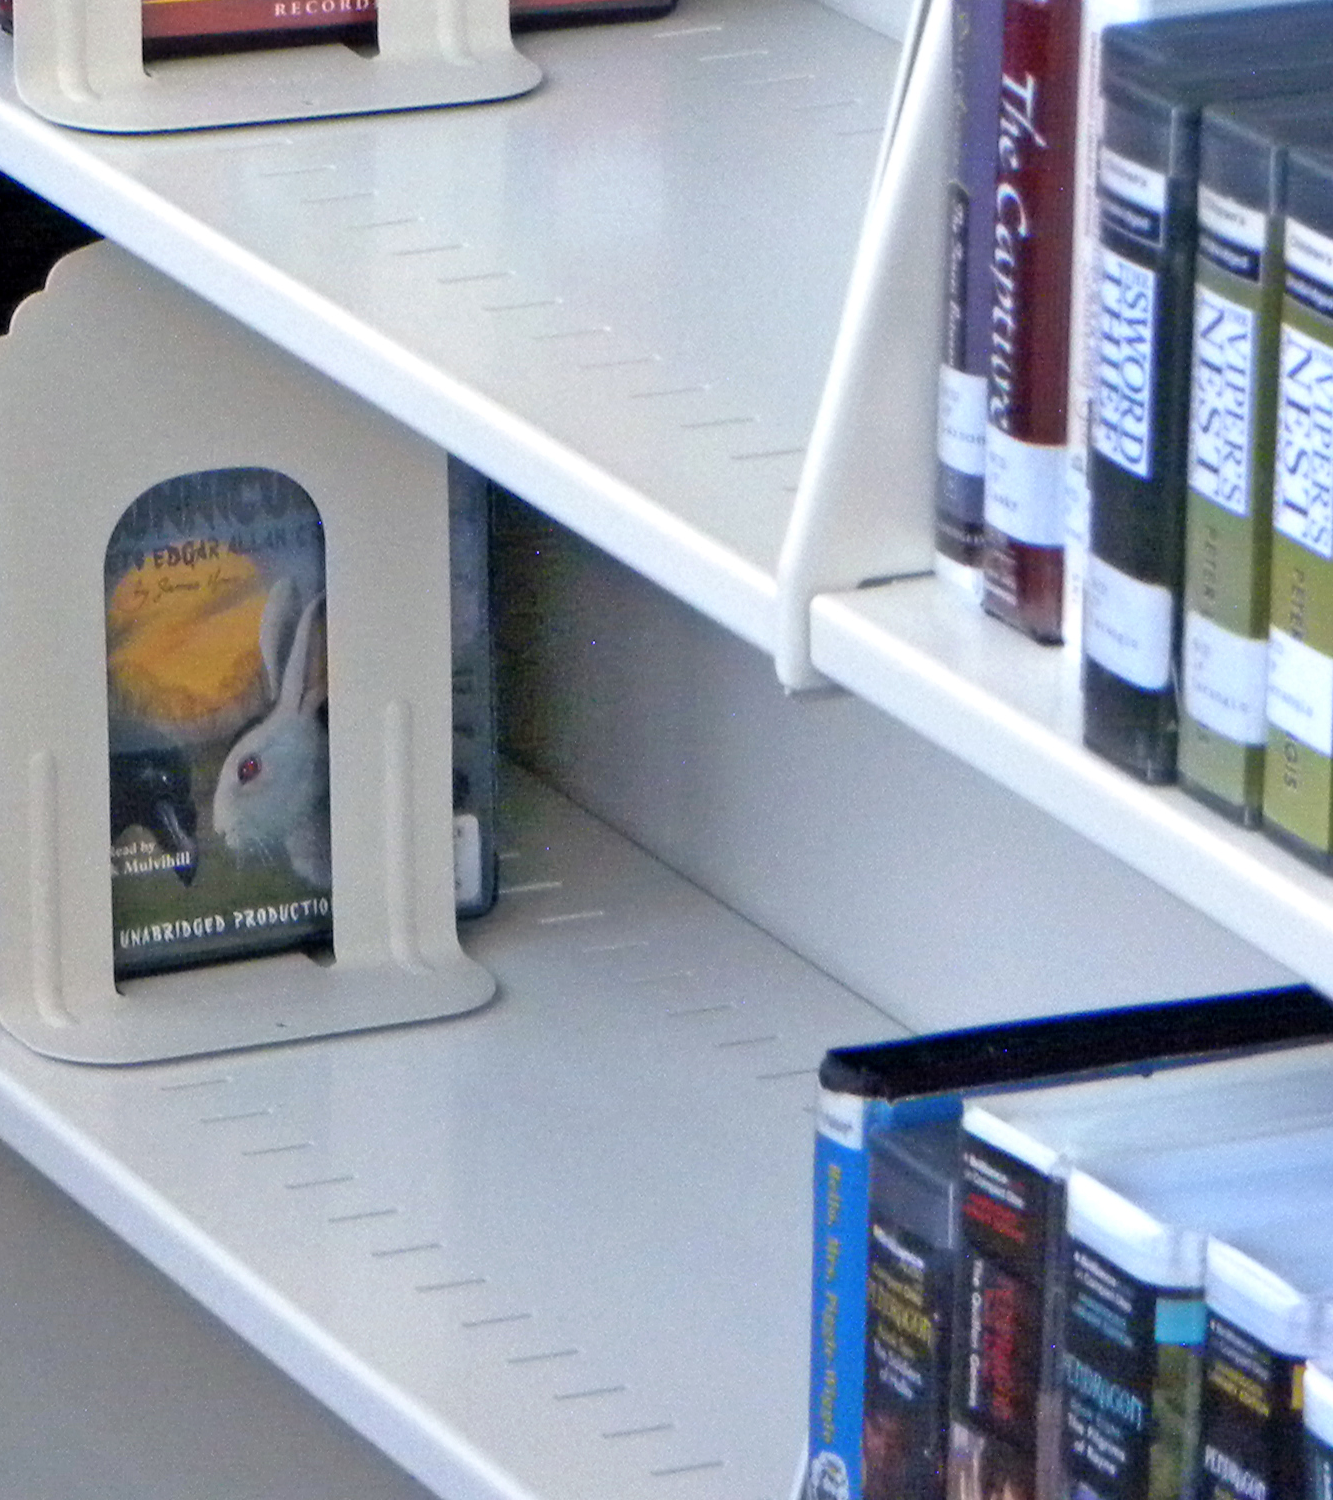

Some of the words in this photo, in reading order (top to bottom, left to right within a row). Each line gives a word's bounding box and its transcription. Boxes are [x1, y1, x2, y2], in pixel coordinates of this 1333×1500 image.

[998, 71, 1048, 173] The
[989, 182, 1029, 431] Capture
[1118, 289, 1151, 466] SWORD
[1196, 303, 1224, 478] NEST
[1221, 326, 1249, 503] VIPER'S
[1282, 347, 1313, 518] NEST
[153, 538, 220, 570] EDGAR
[1201, 526, 1218, 600] PETER
[119, 916, 226, 949] UNABRIDGED
[232, 897, 330, 930] PRODUCTIO
[123, 851, 192, 874] Mulvihill
